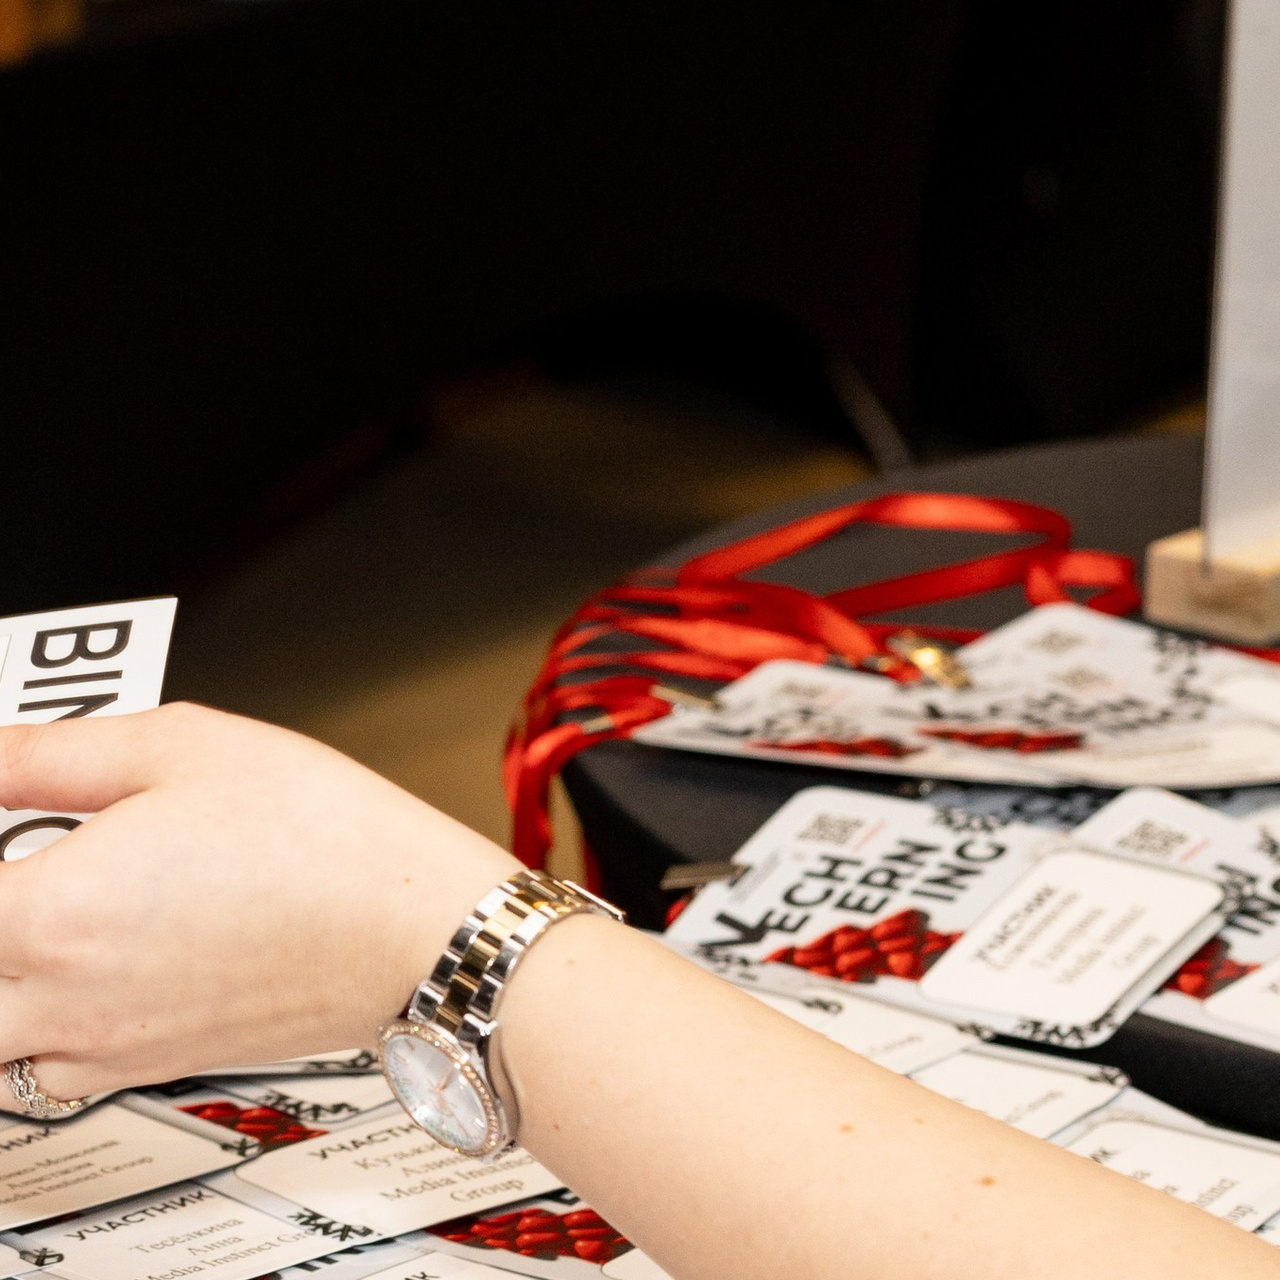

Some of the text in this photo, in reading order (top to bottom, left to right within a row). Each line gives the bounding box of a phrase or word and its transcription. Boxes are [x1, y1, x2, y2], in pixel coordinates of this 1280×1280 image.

[308, 1122, 420, 1160] УЧАСТН
[66, 1189, 216, 1242] УЧАСТНИК
[199, 1241, 282, 1269] Instinct
